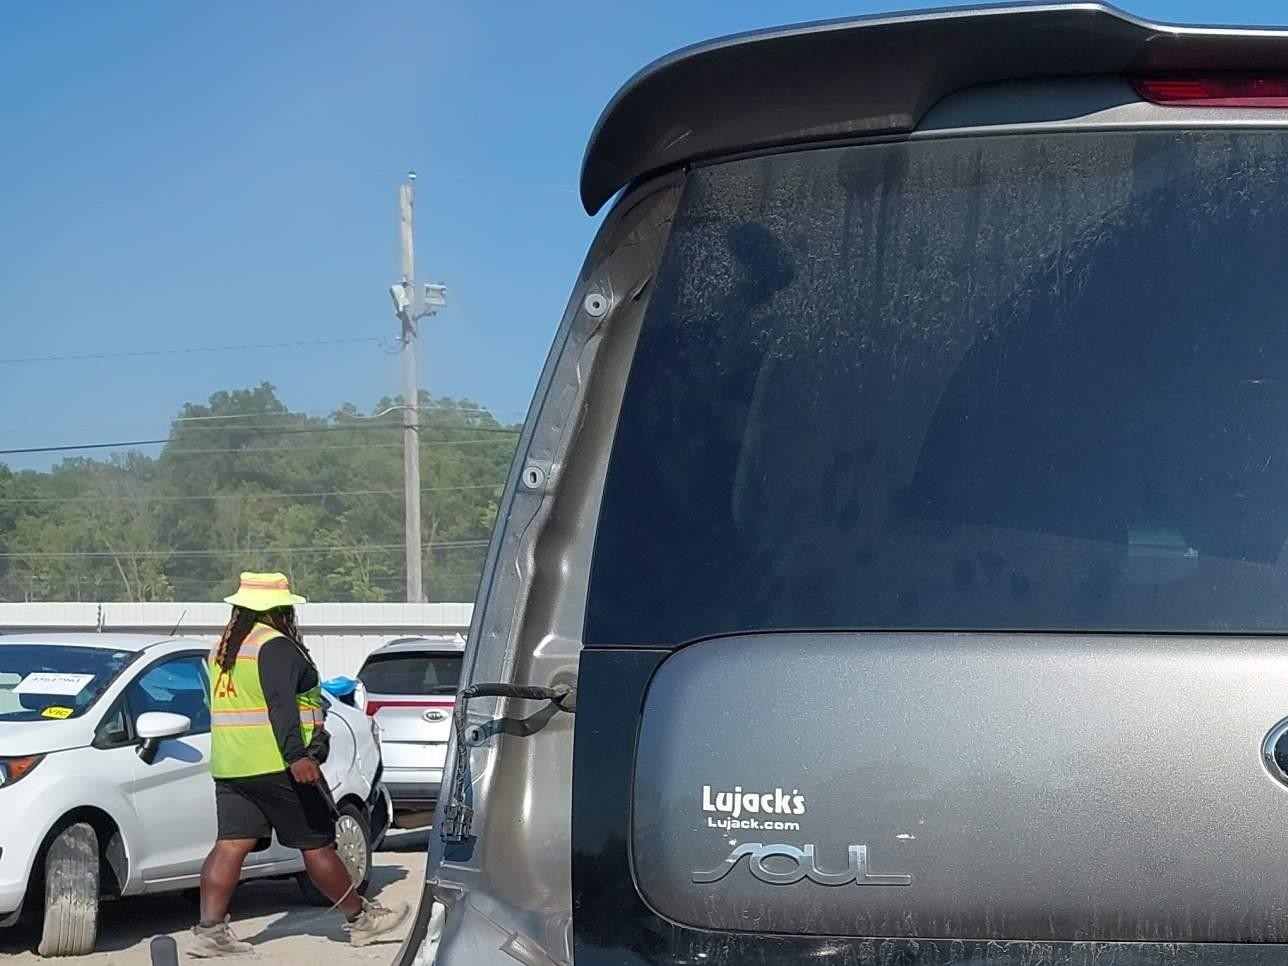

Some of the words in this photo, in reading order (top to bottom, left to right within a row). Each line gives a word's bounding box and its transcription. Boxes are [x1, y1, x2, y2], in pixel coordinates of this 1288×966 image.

[702, 785, 806, 818] Lujack's
[707, 817, 800, 831] Lujack.com
[691, 842, 912, 887] SOUL
